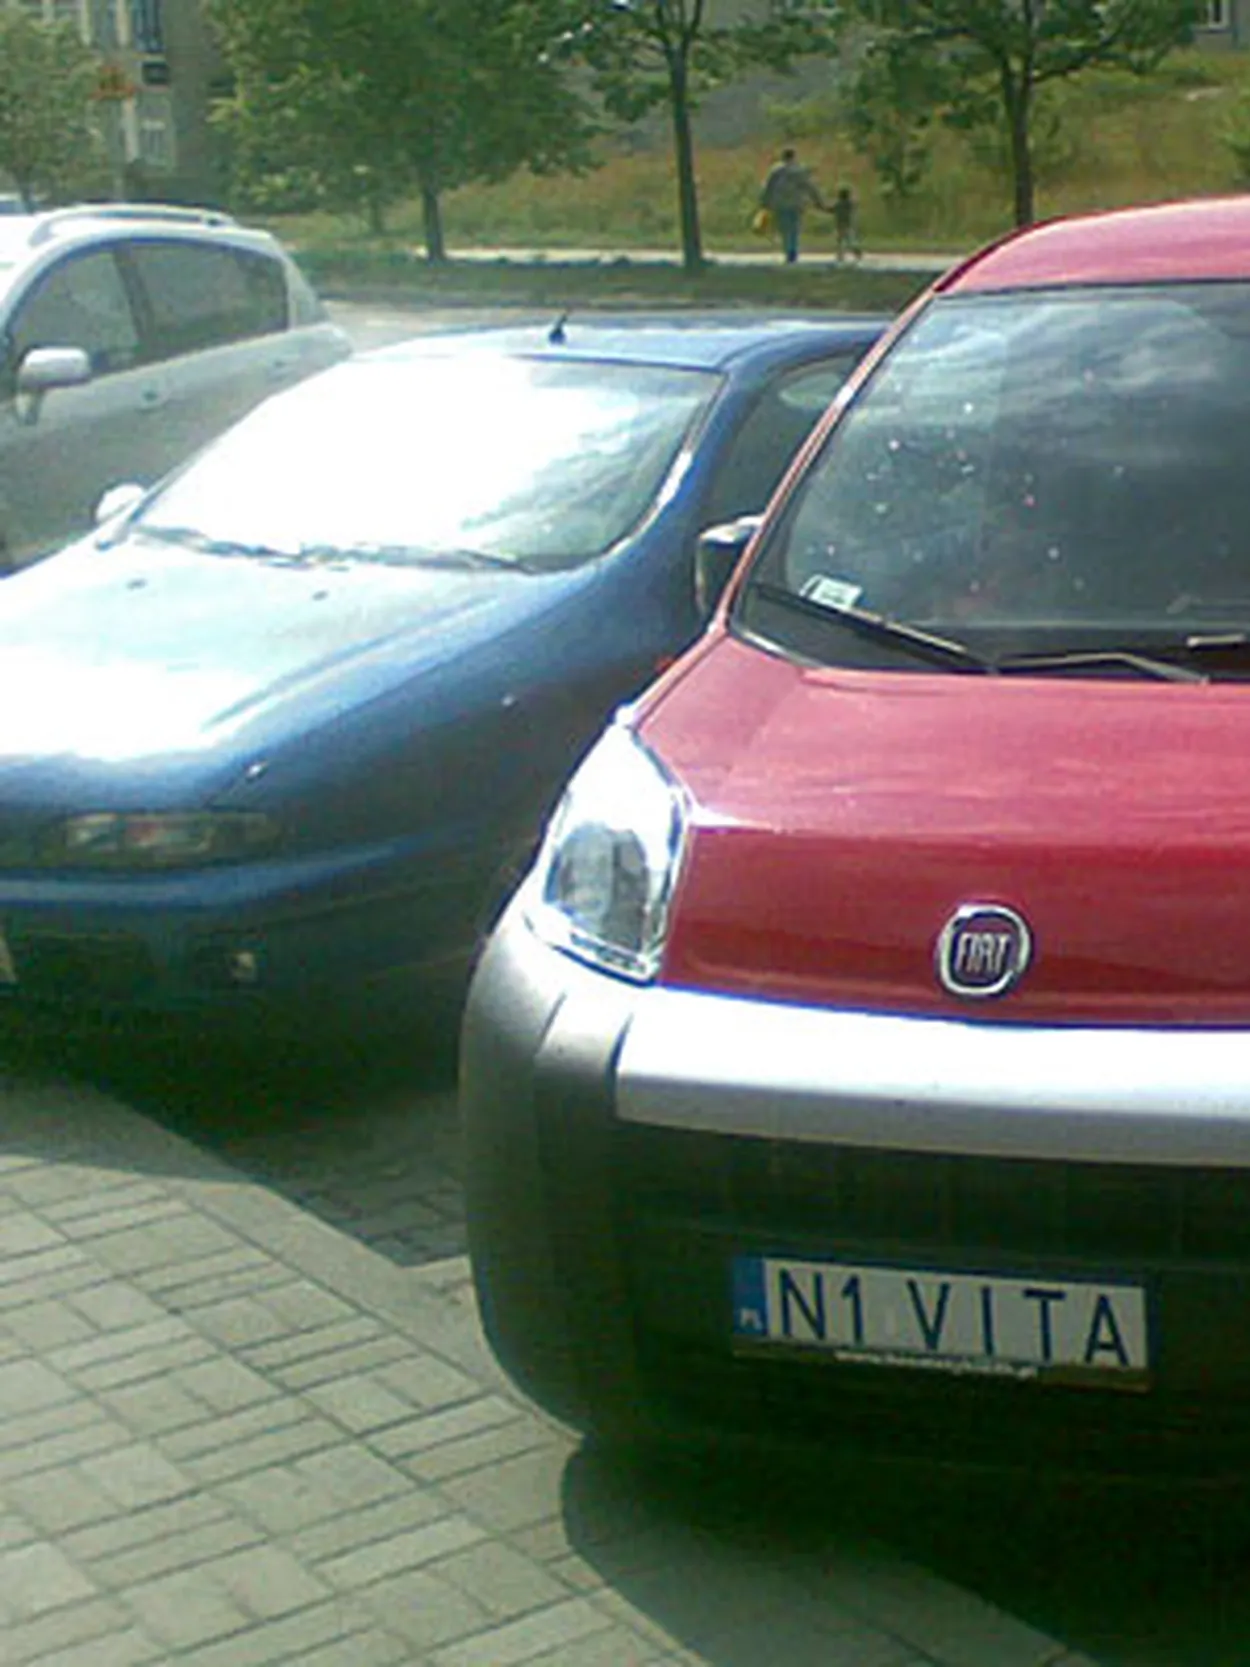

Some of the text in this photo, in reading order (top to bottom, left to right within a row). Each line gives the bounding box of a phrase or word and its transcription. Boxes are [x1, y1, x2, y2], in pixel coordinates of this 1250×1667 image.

[954, 932, 1012, 975] FIAT
[779, 1267, 1130, 1369] N1 VITA
